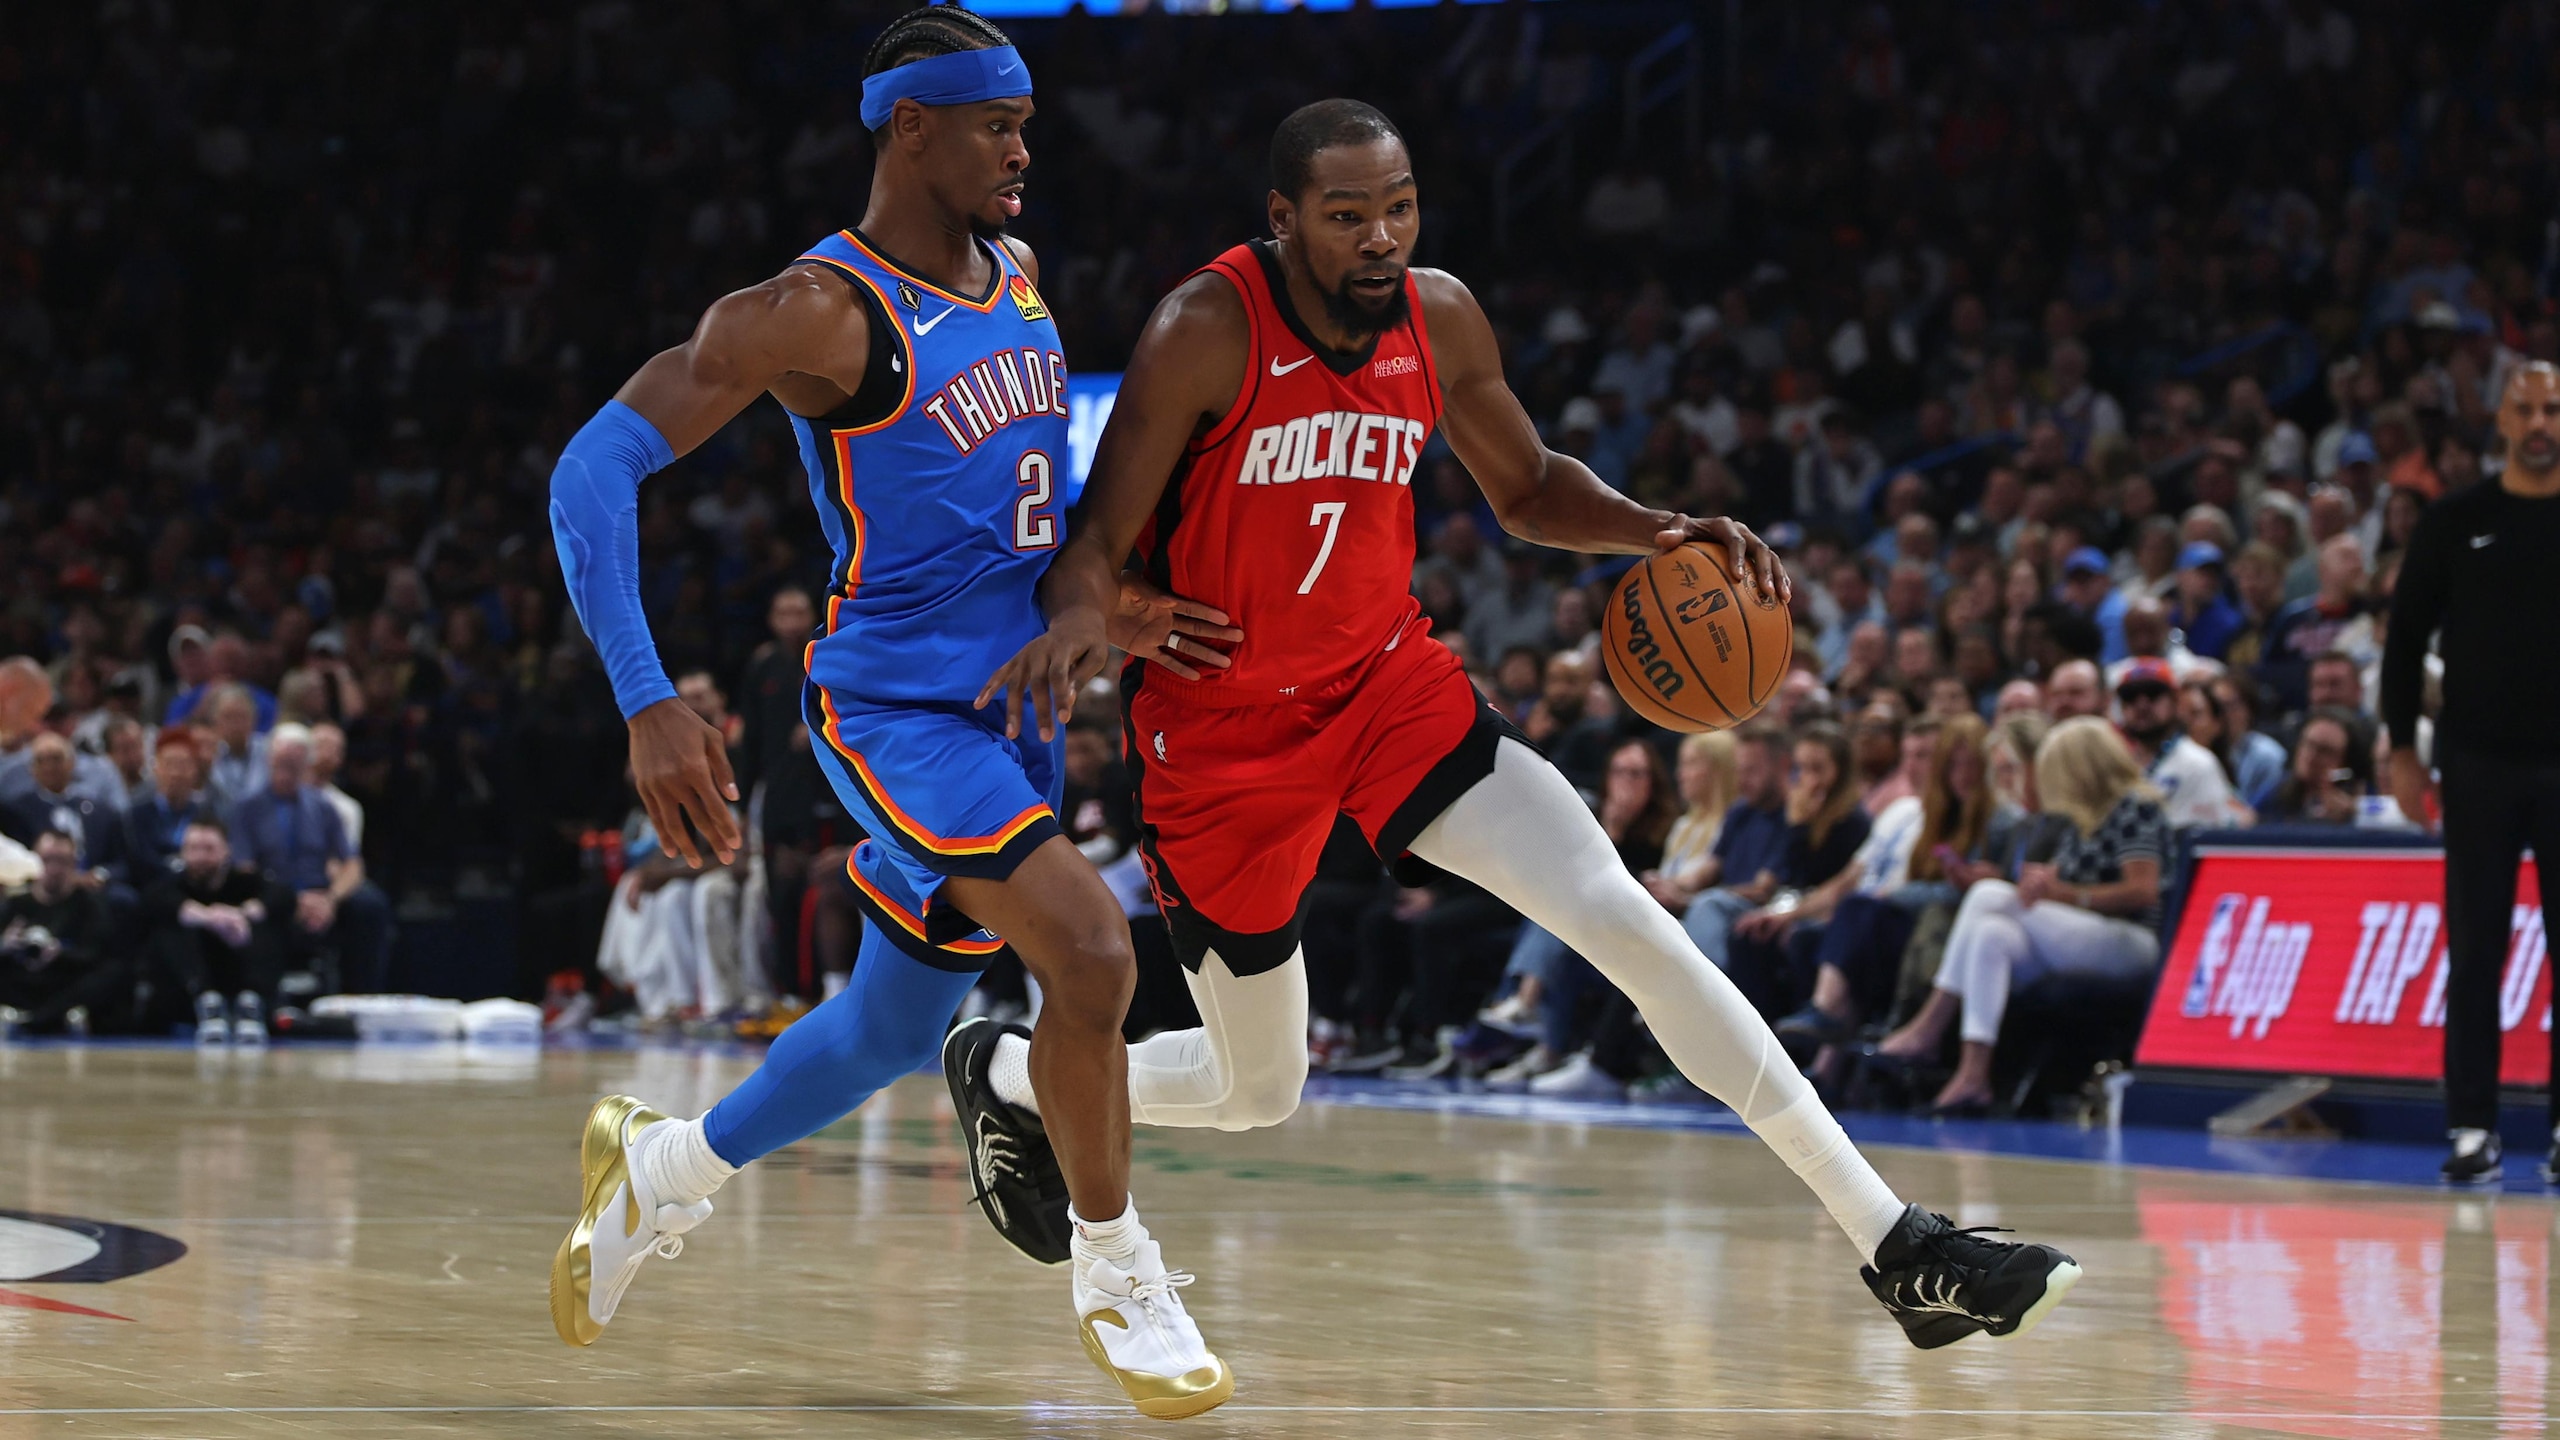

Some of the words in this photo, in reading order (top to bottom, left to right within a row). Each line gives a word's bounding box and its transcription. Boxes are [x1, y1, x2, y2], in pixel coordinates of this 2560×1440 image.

[922, 347, 1069, 457] THUNDE
[1374, 362, 1418, 378] HERMANN
[1237, 411, 1424, 486] ROCKETS
[1014, 449, 1057, 552] 2
[1297, 502, 1347, 594] 7
[1623, 577, 1685, 701] Wilson
[2213, 896, 2312, 1039] App
[2335, 902, 2442, 1025] TAP
